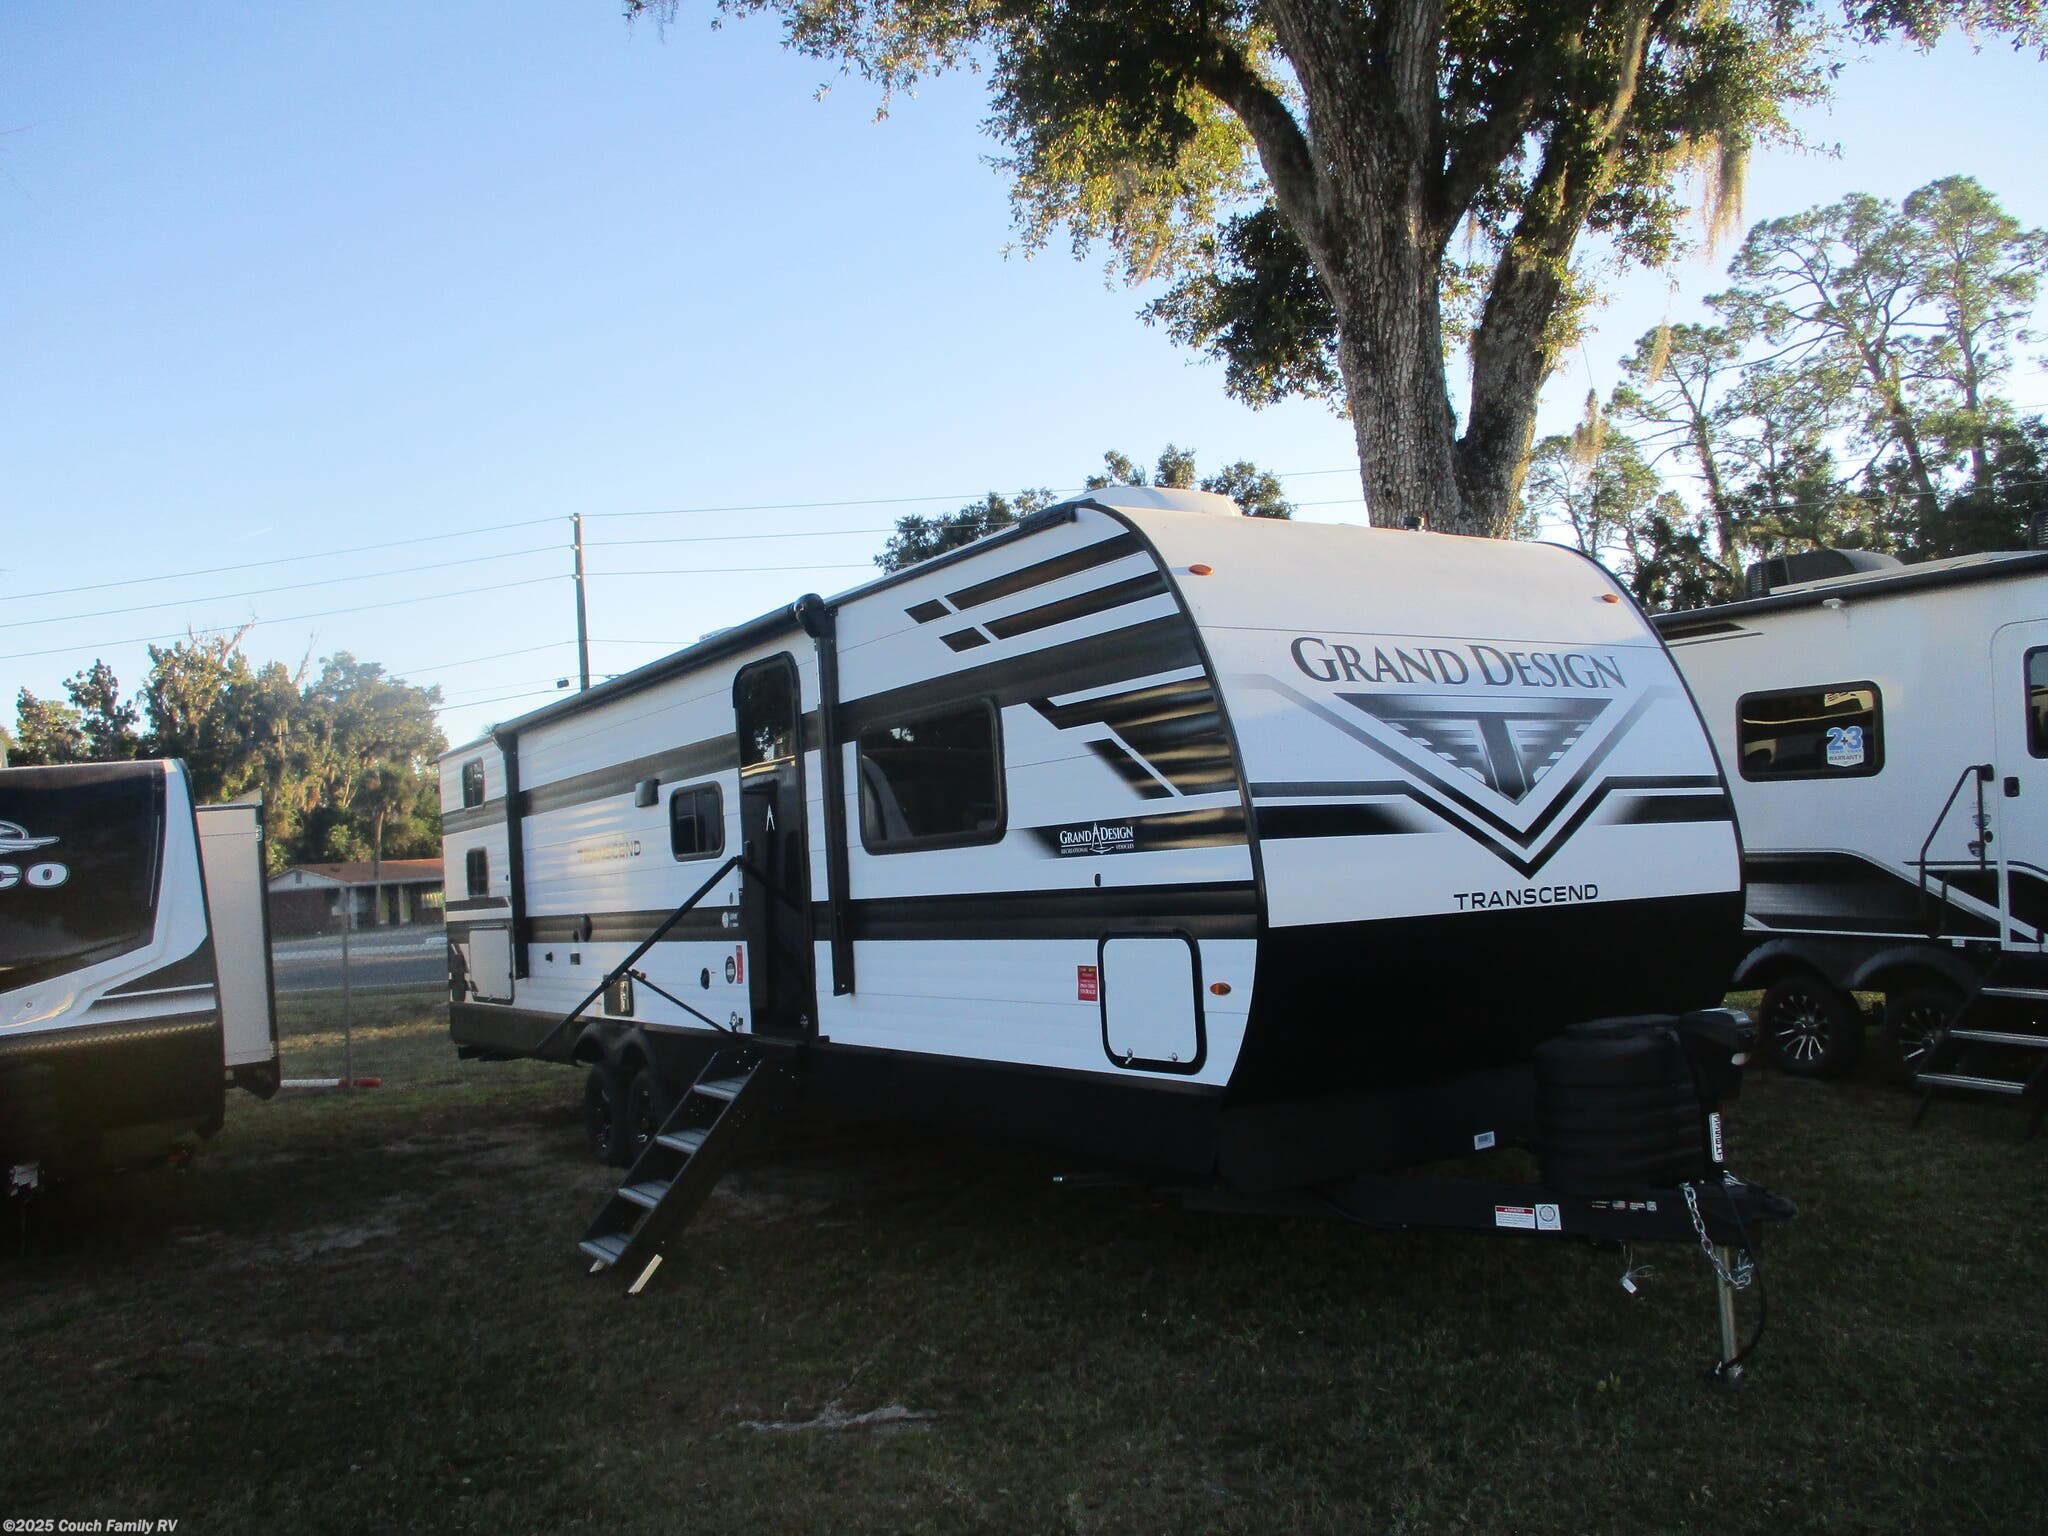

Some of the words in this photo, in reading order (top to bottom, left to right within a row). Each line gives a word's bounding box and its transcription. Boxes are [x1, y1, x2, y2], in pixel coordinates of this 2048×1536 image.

[1290, 636, 1469, 685] GRAND
[1467, 645, 1627, 689] DESIGN
[1060, 830, 1091, 844] GRAND
[1100, 826, 1134, 841] DESIGN
[577, 840, 641, 862] TSCEND
[1453, 883, 1598, 911] TRANSCEND
